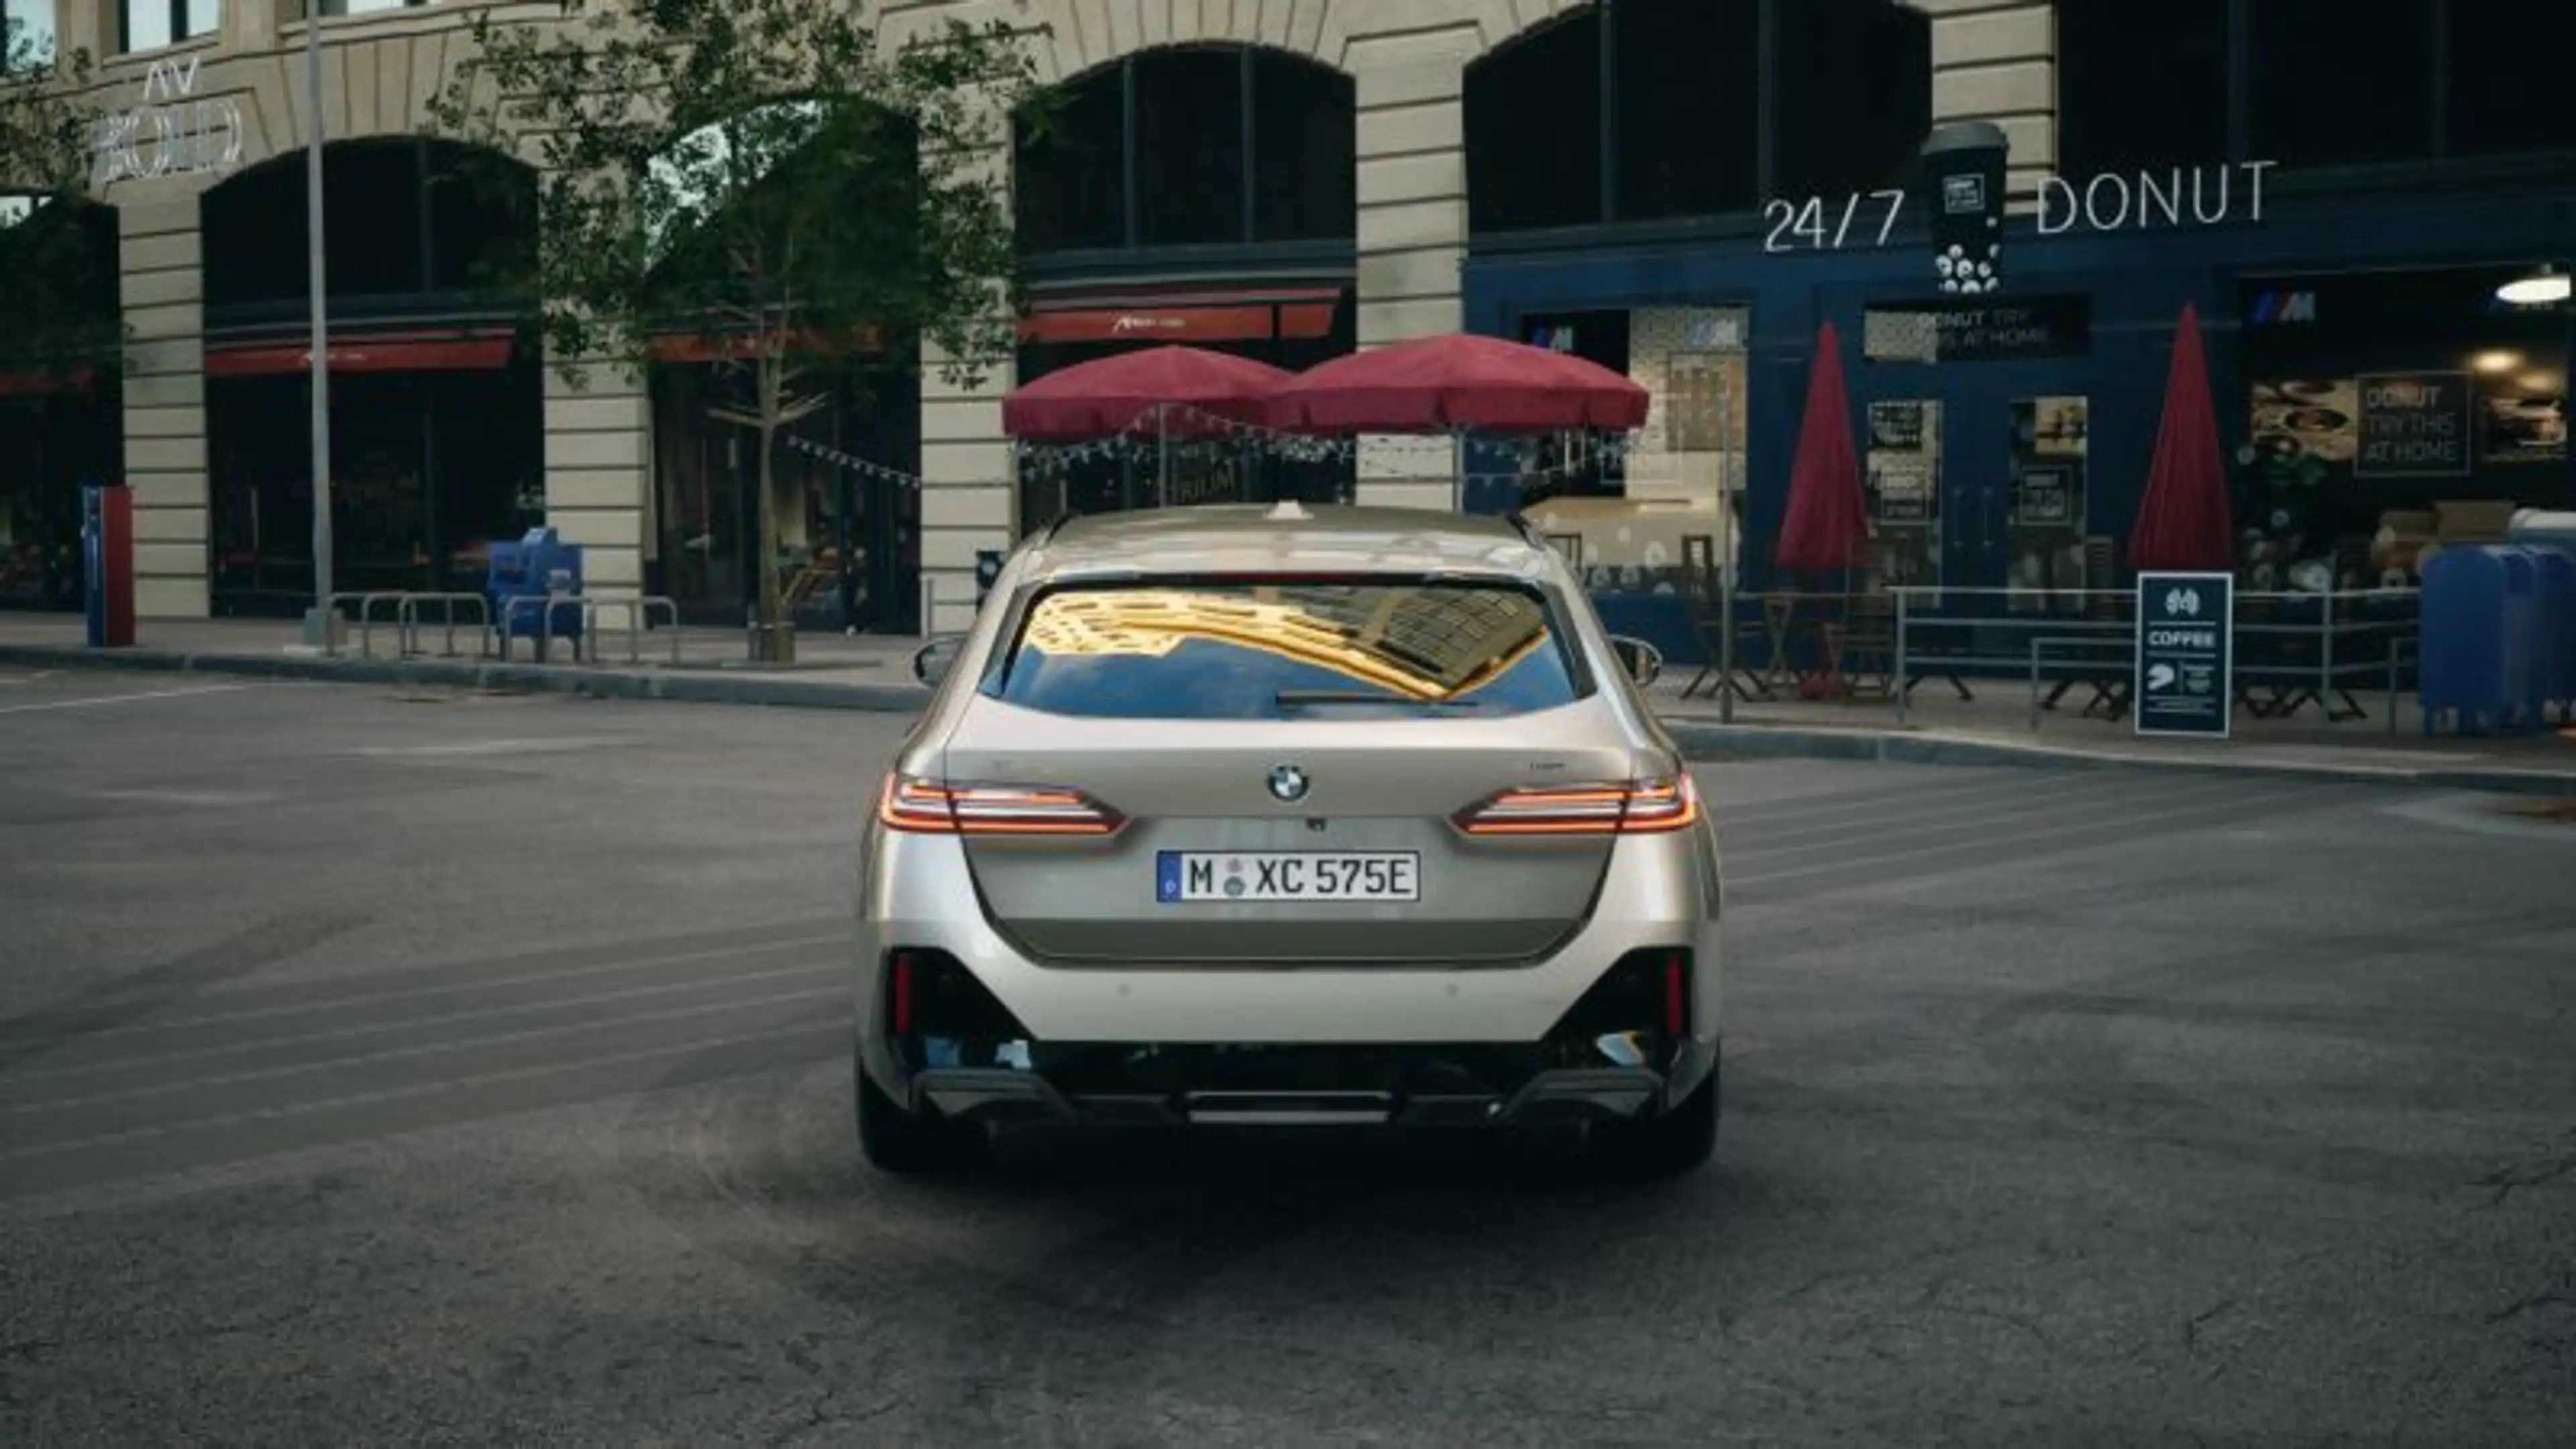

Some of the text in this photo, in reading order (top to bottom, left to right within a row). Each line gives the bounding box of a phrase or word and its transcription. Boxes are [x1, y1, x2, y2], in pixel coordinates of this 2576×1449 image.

[2037, 160, 2278, 233] DONUT
[1765, 189, 1904, 252] 24/7
[2367, 385, 2442, 409] DONUT
[2369, 414, 2404, 435] TRY
[2366, 439, 2457, 464] AT HOME
[2148, 631, 2216, 648] COFFEE
[1189, 859, 1411, 894] M XC 575E
